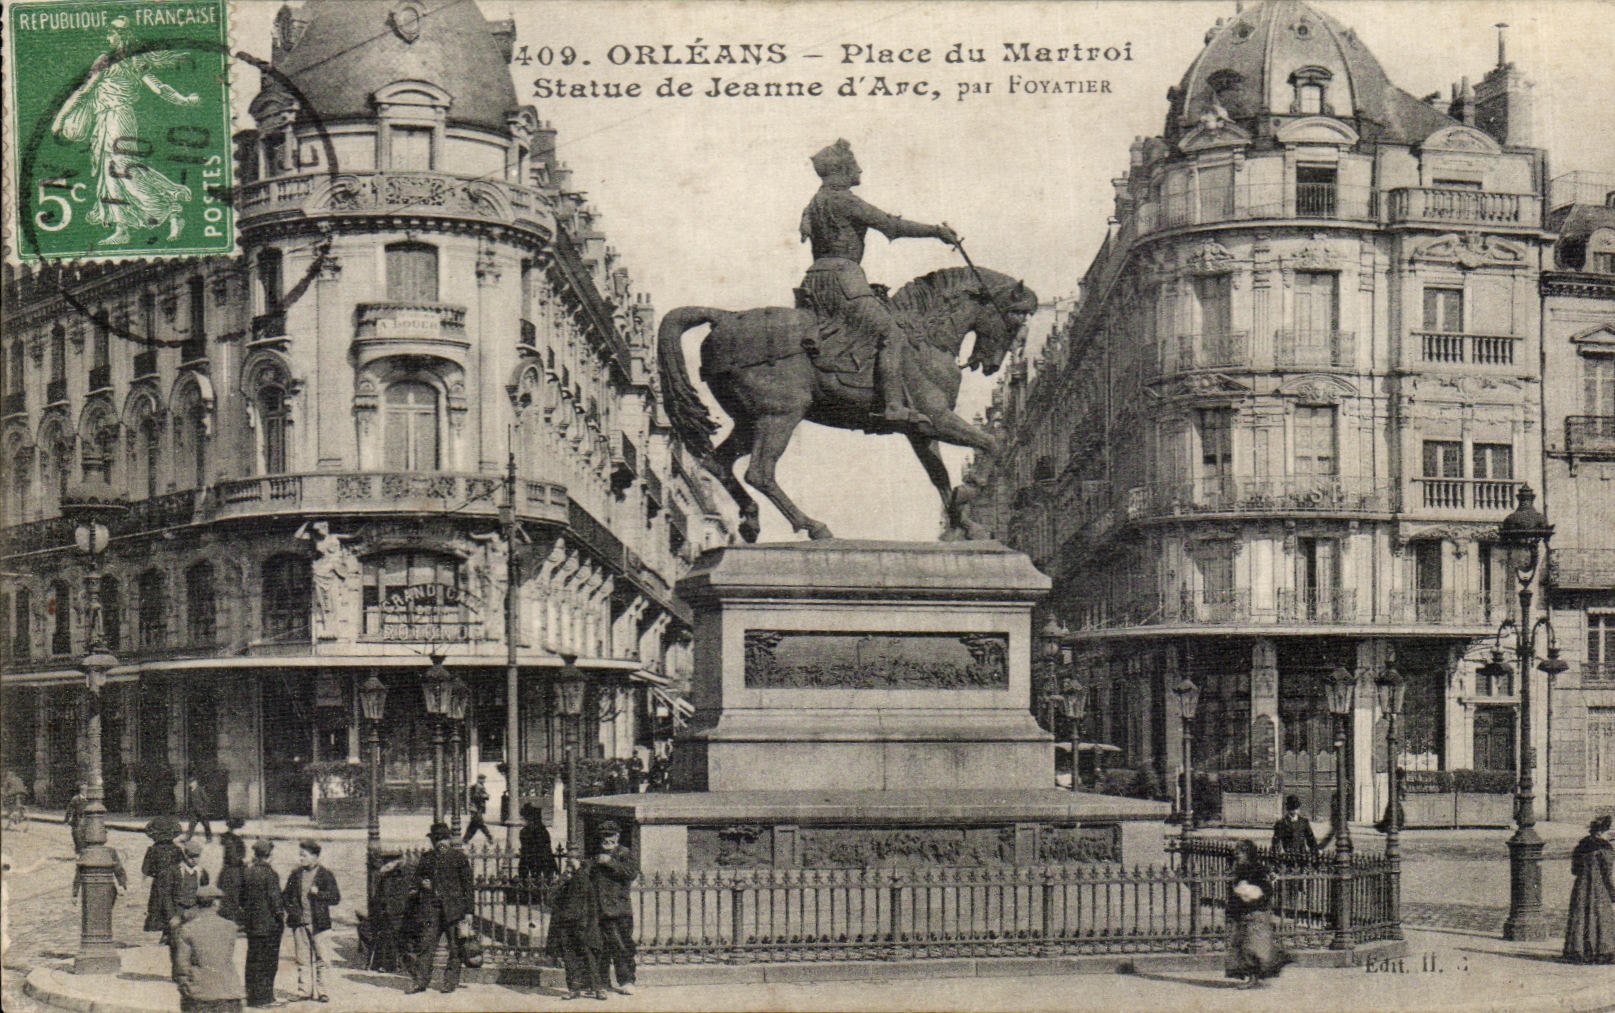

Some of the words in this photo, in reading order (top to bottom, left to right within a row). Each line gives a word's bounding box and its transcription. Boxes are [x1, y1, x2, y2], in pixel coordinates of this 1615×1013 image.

[135, 7, 216, 28] FRANÇAISE
[203, 154, 223, 237] POSTES
[382, 584, 436, 612] GRAND
